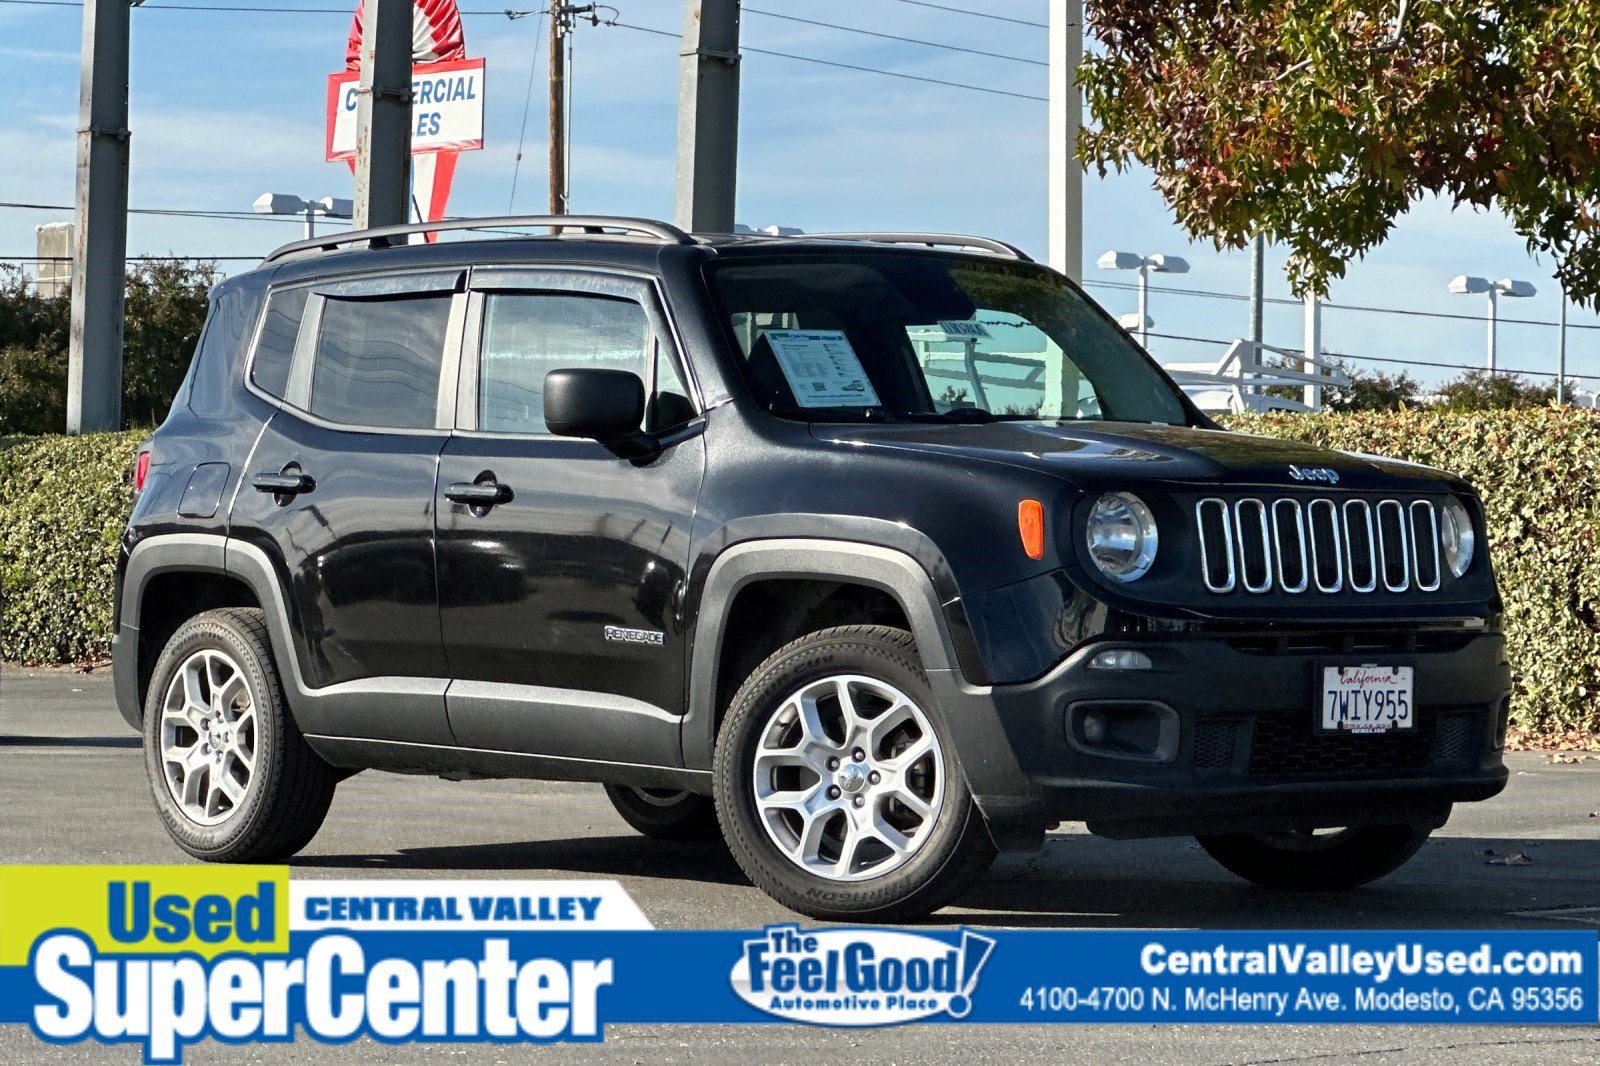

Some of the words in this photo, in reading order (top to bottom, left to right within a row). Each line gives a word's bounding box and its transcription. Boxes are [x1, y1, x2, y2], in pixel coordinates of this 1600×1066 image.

[345, 75, 476, 111] CERCIAL
[1288, 464, 1340, 484] Jeep
[604, 625, 664, 645] RENEGADE
[1340, 669, 1398, 689] California
[1327, 690, 1408, 720] 7WIY955
